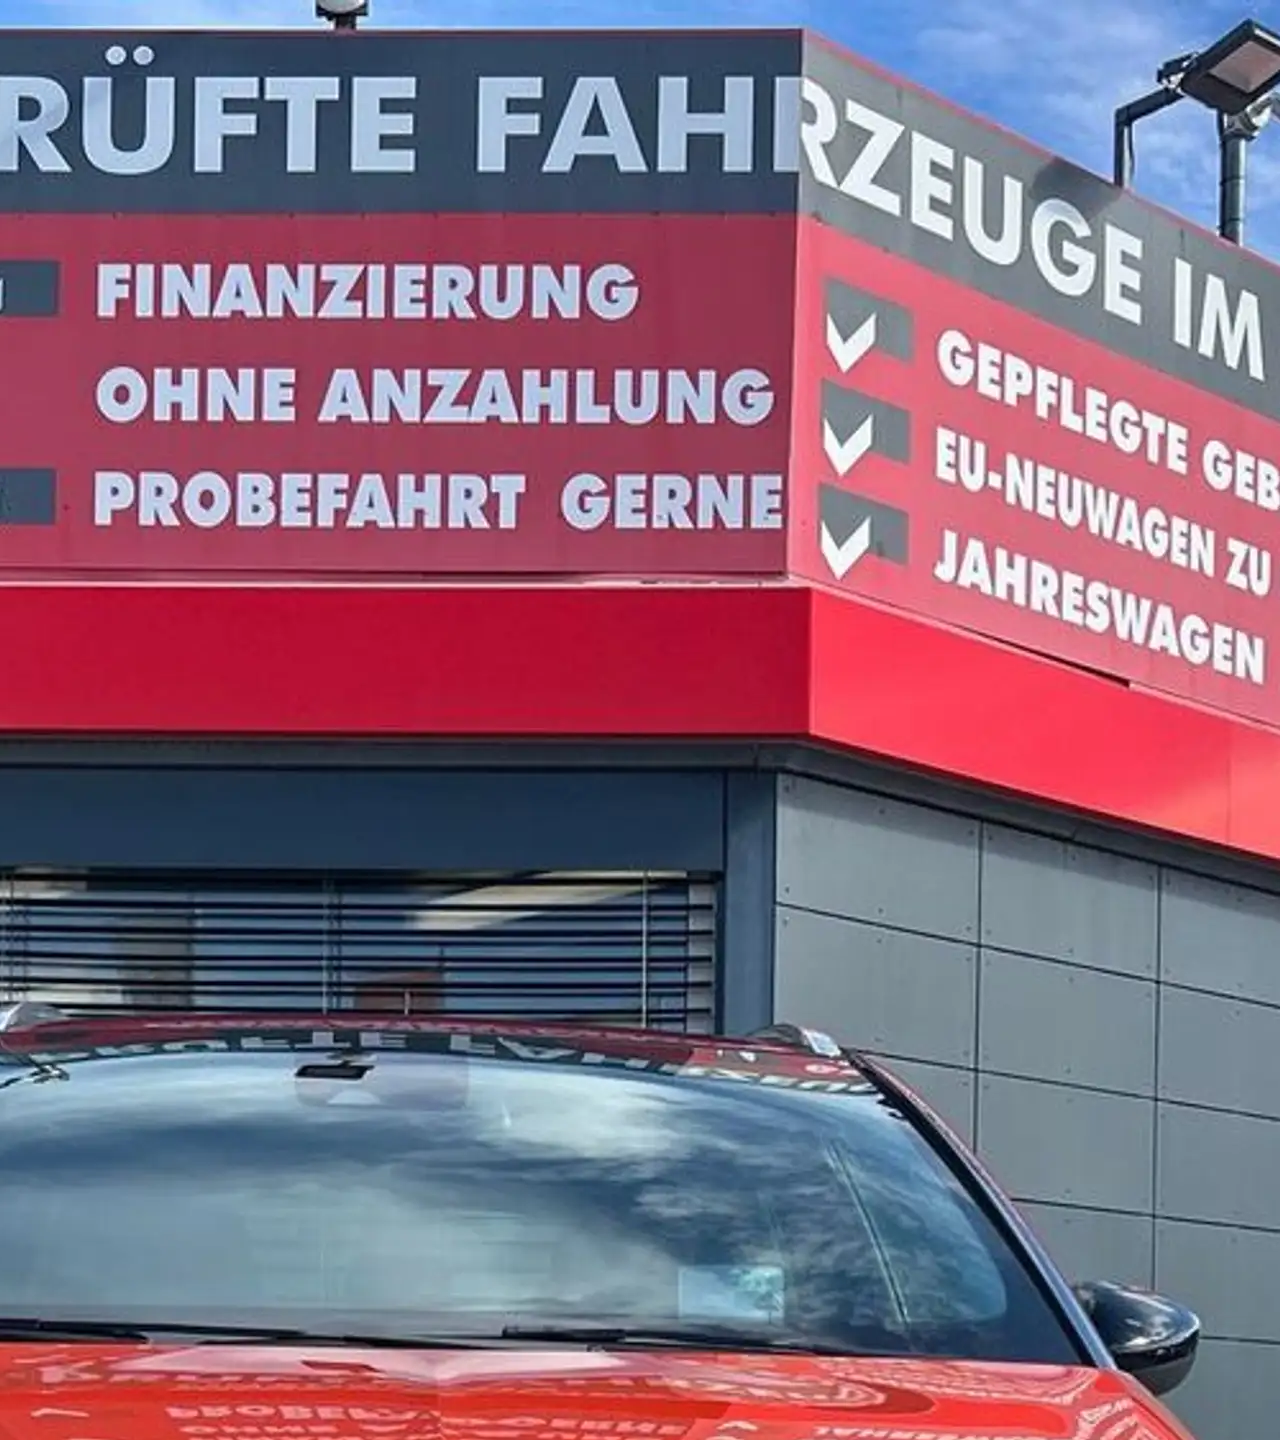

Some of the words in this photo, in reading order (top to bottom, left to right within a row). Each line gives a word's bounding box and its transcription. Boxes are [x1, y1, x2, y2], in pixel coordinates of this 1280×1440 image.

[95, 263, 638, 322] FINANZIERUNG
[1174, 255, 1267, 383] IM
[95, 367, 295, 424] OHNE
[318, 367, 775, 426] ANZAHLUNG
[937, 329, 1189, 475] GEPFLEGTE
[93, 472, 526, 530] PROBEFAHRT
[560, 473, 784, 531] GERNE
[935, 426, 1214, 578] EU-NEUWAGEN
[1225, 536, 1271, 597] ZU
[934, 531, 1266, 685] JAHRESWAGEN
